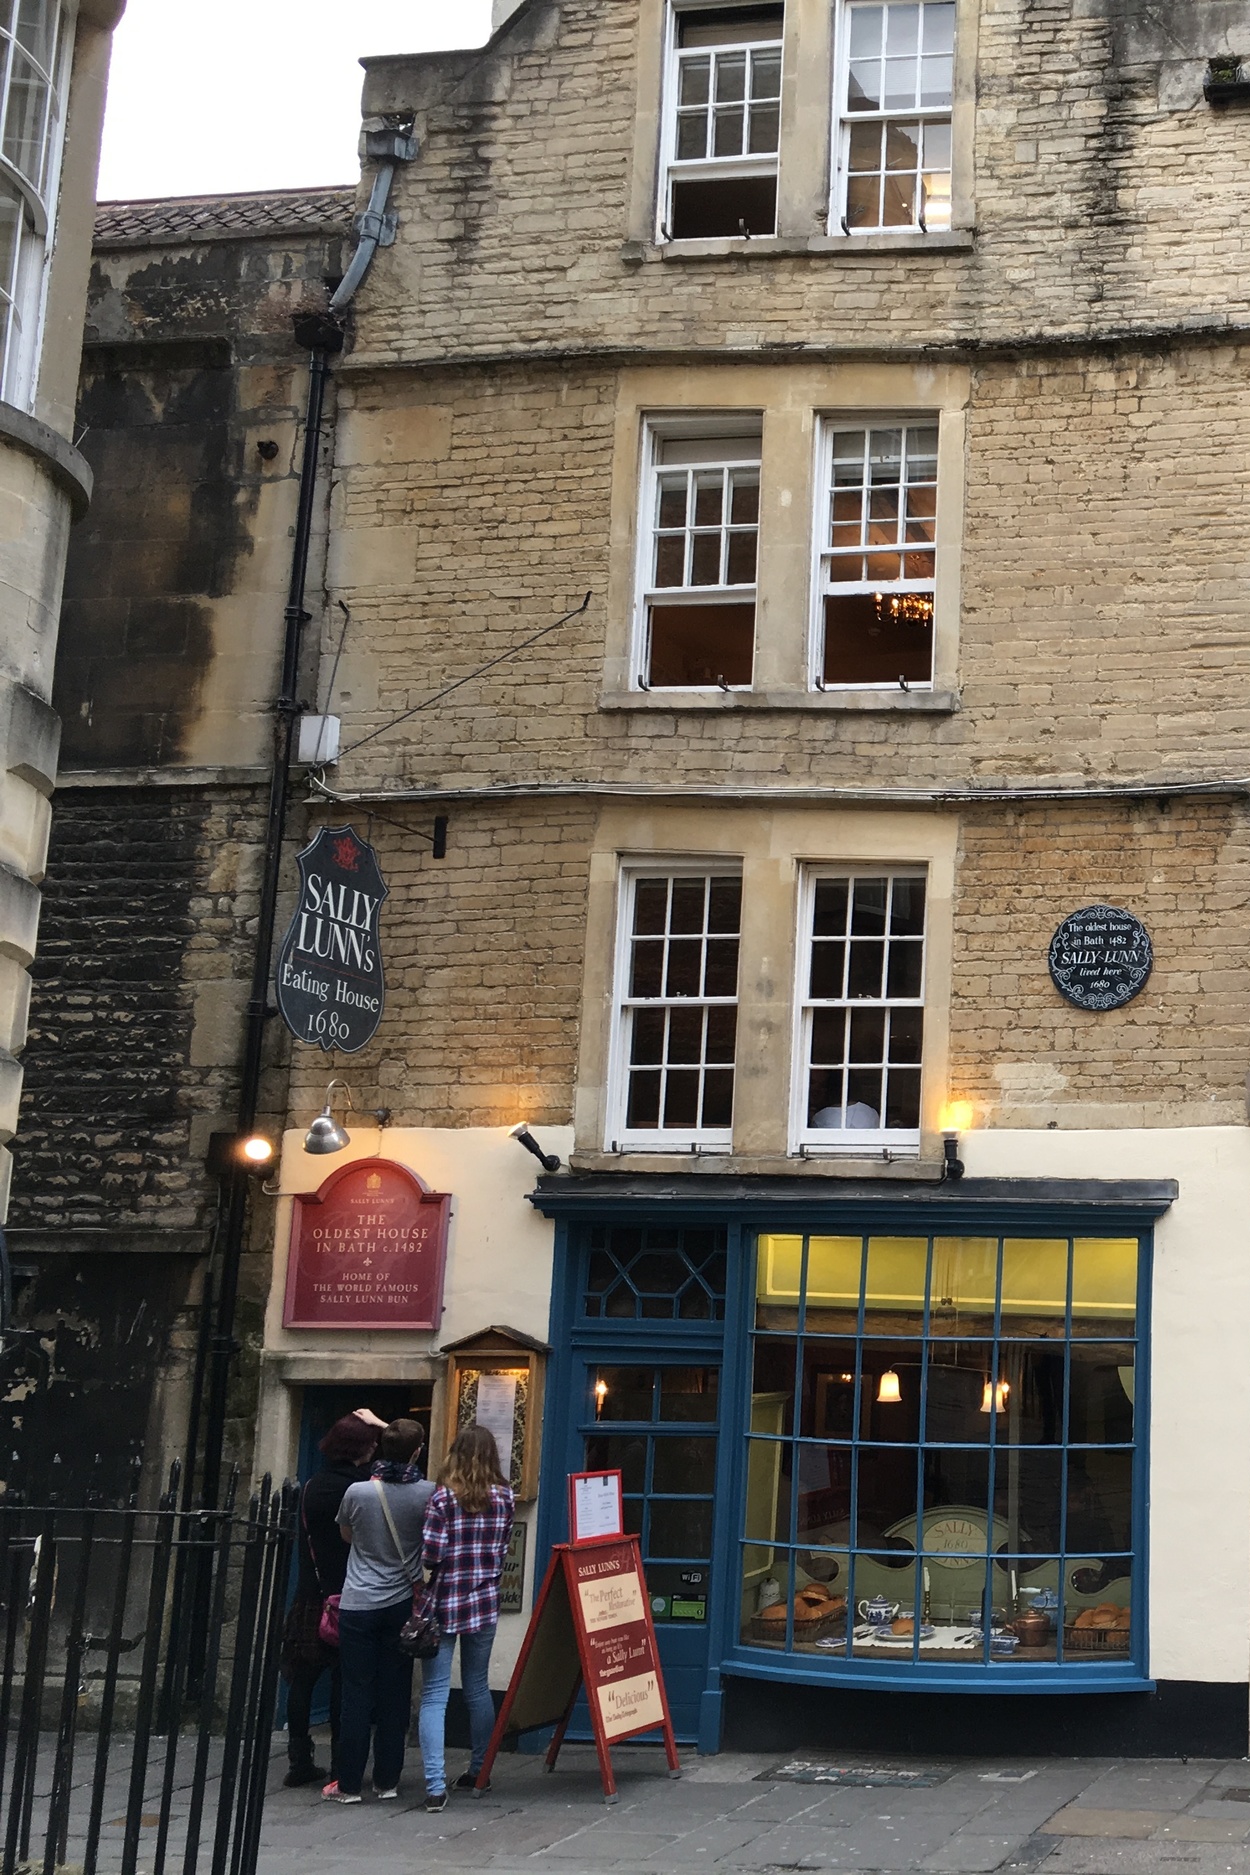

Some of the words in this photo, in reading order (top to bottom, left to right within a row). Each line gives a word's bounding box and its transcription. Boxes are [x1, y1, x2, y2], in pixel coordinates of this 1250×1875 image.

[305, 873, 379, 931] SALLY
[1068, 922, 1083, 932] The
[1085, 921, 1107, 931] oldest
[1109, 921, 1131, 931] house
[296, 911, 375, 973] LUNN's
[1073, 936, 1081, 945] in
[1084, 935, 1103, 945] Bath
[1109, 935, 1127, 946] 1482
[1061, 950, 1101, 964] SALLY
[1104, 950, 1139, 963] LUNN
[1080, 967, 1101, 976] lived
[1103, 966, 1122, 976] here
[281, 963, 330, 1002] Eating
[335, 979, 380, 1013] House
[1090, 979, 1110, 988] 1680
[307, 1010, 350, 1040] 1680
[357, 1214, 386, 1225] THE
[313, 1228, 370, 1239] OLDEST
[377, 1228, 429, 1239] HOUSE
[316, 1242, 331, 1253] IN
[338, 1242, 376, 1253] BATH
[383, 1242, 423, 1253] c.1482
[342, 1272, 372, 1281] HOME
[376, 1272, 391, 1281] OF
[313, 1283, 332, 1292] THE
[337, 1283, 372, 1292] WORLD
[376, 1283, 419, 1292] FAMOUS
[320, 1294, 351, 1303] SALLY
[355, 1294, 383, 1304] LUNN
[388, 1295, 409, 1304] BUN
[934, 1521, 976, 1539] SALLY
[944, 1539, 969, 1549] 1680
[578, 1563, 597, 1577] SALLY
